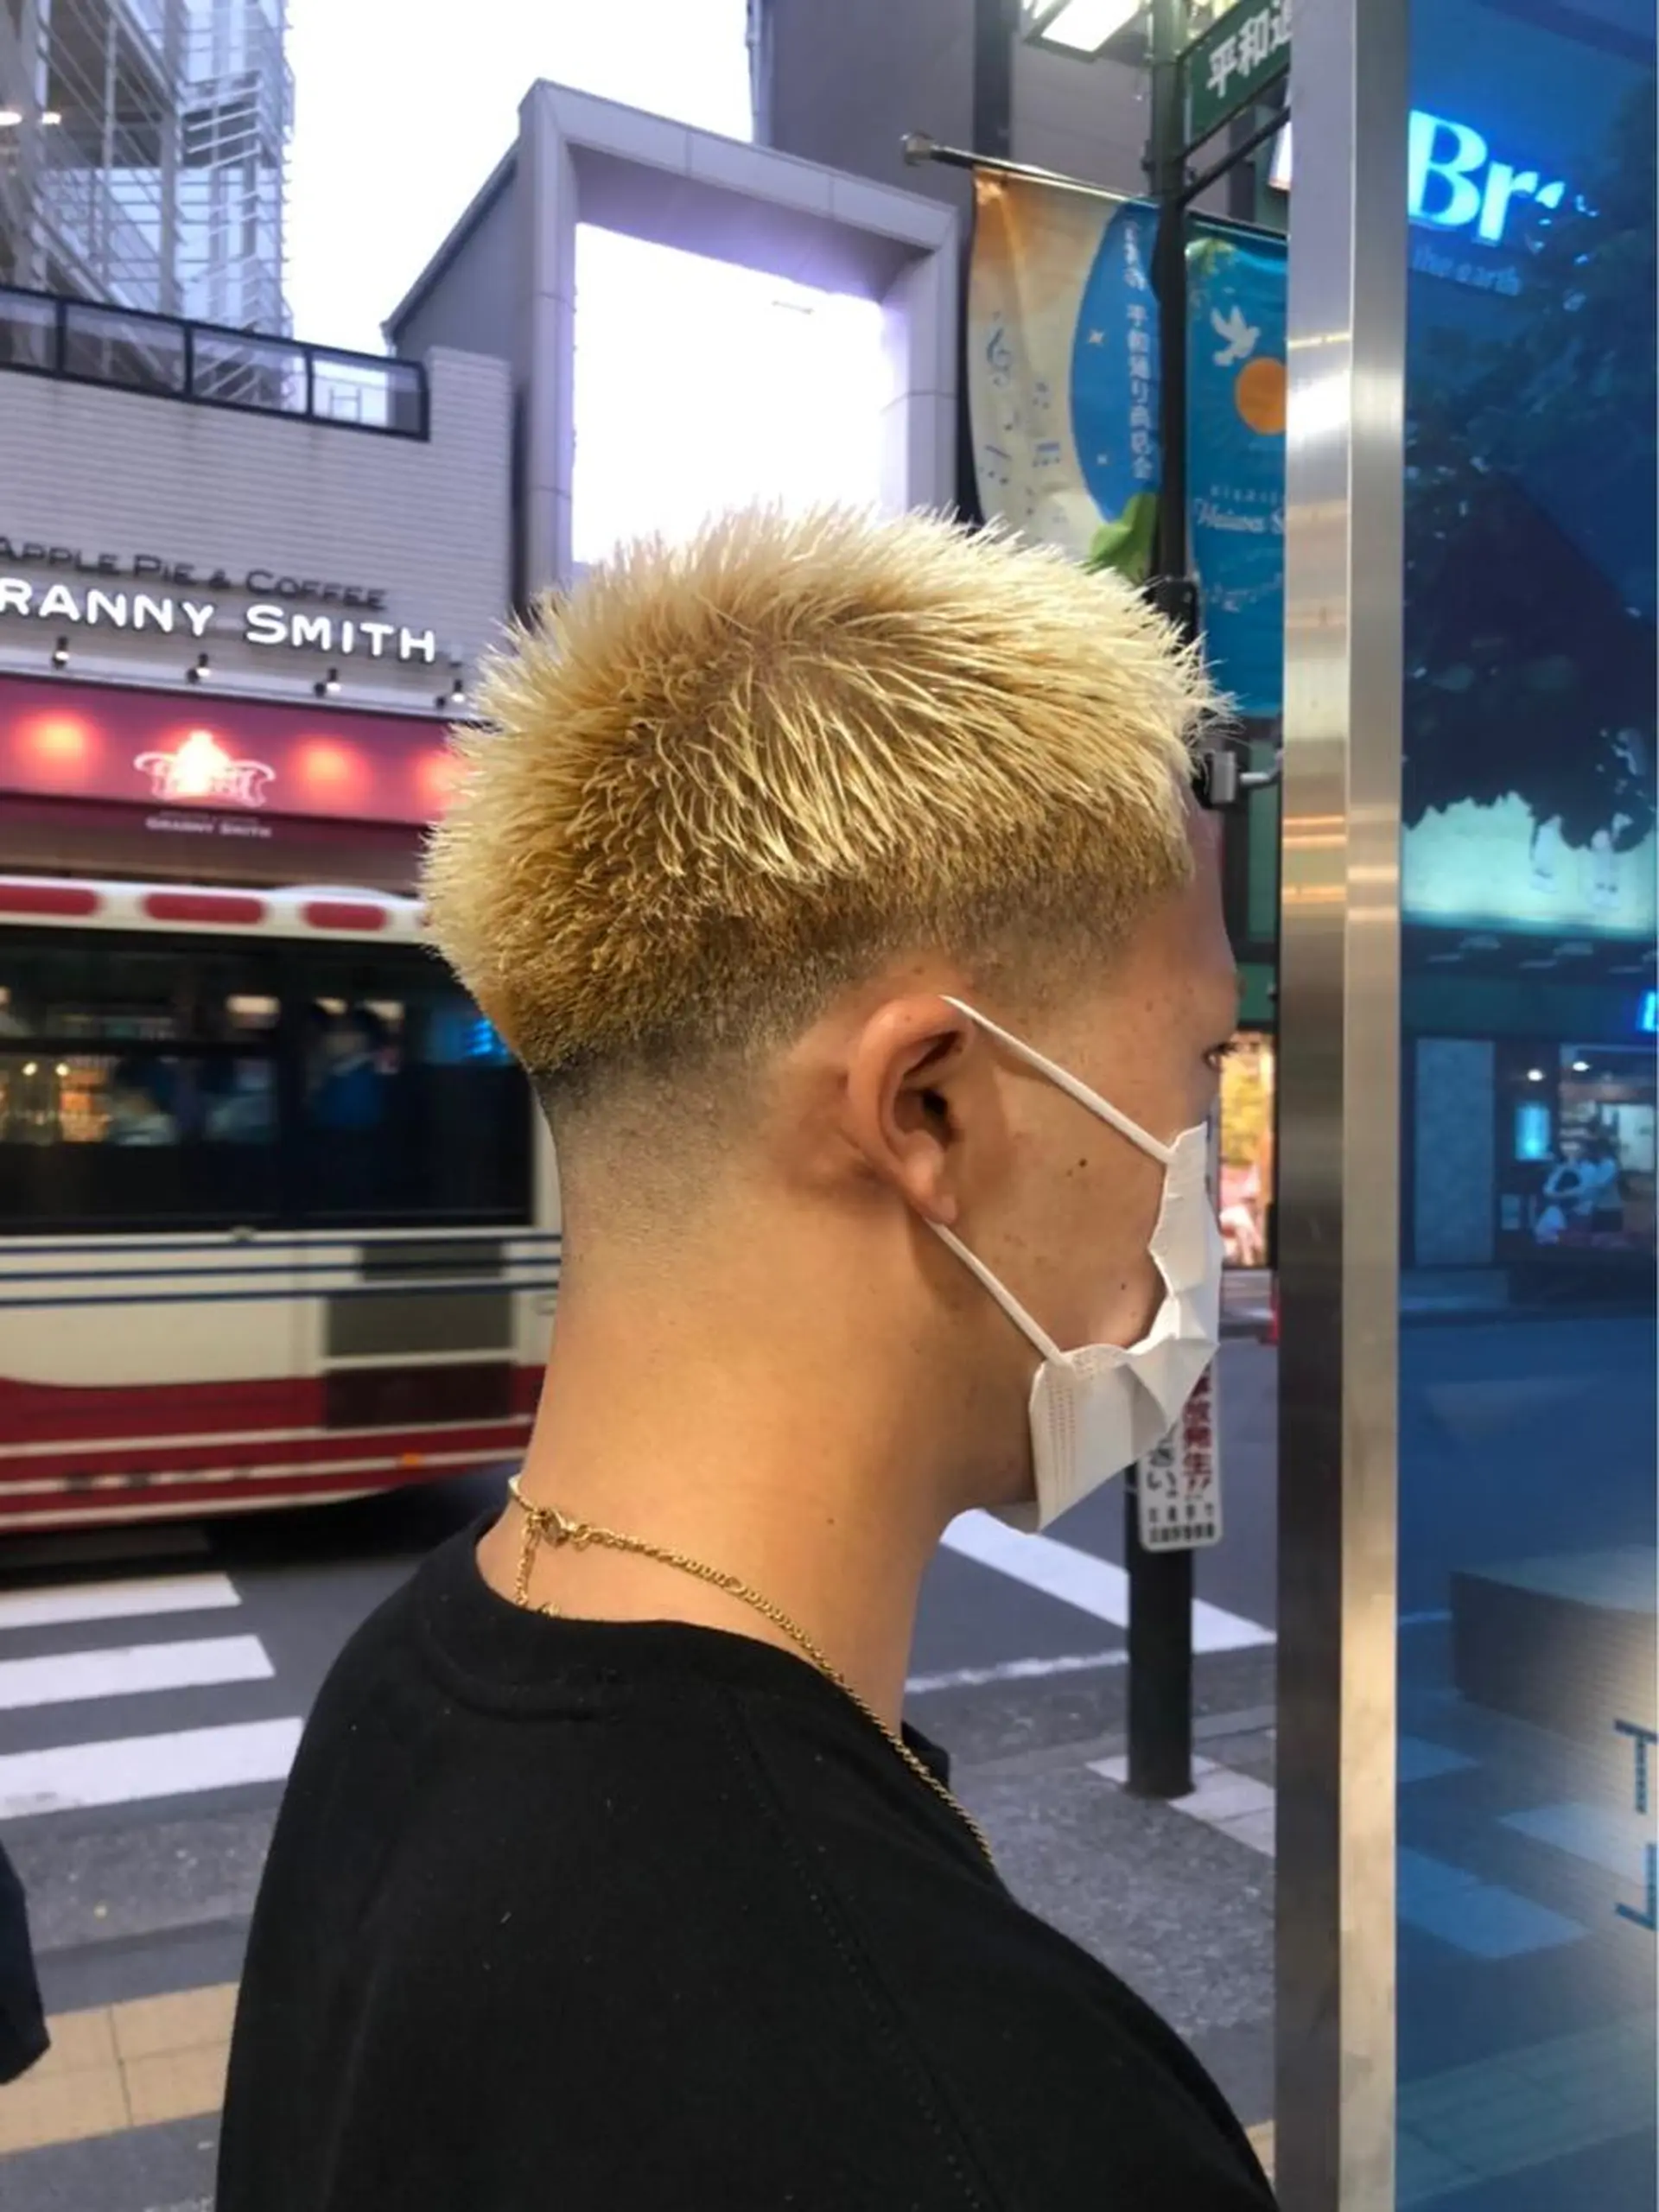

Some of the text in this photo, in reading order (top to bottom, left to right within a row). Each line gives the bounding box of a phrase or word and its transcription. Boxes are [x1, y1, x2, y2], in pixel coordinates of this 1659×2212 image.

[0, 537, 120, 576] APPLE
[245, 569, 388, 611] COFFEE
[246, 604, 435, 663] SMITH
